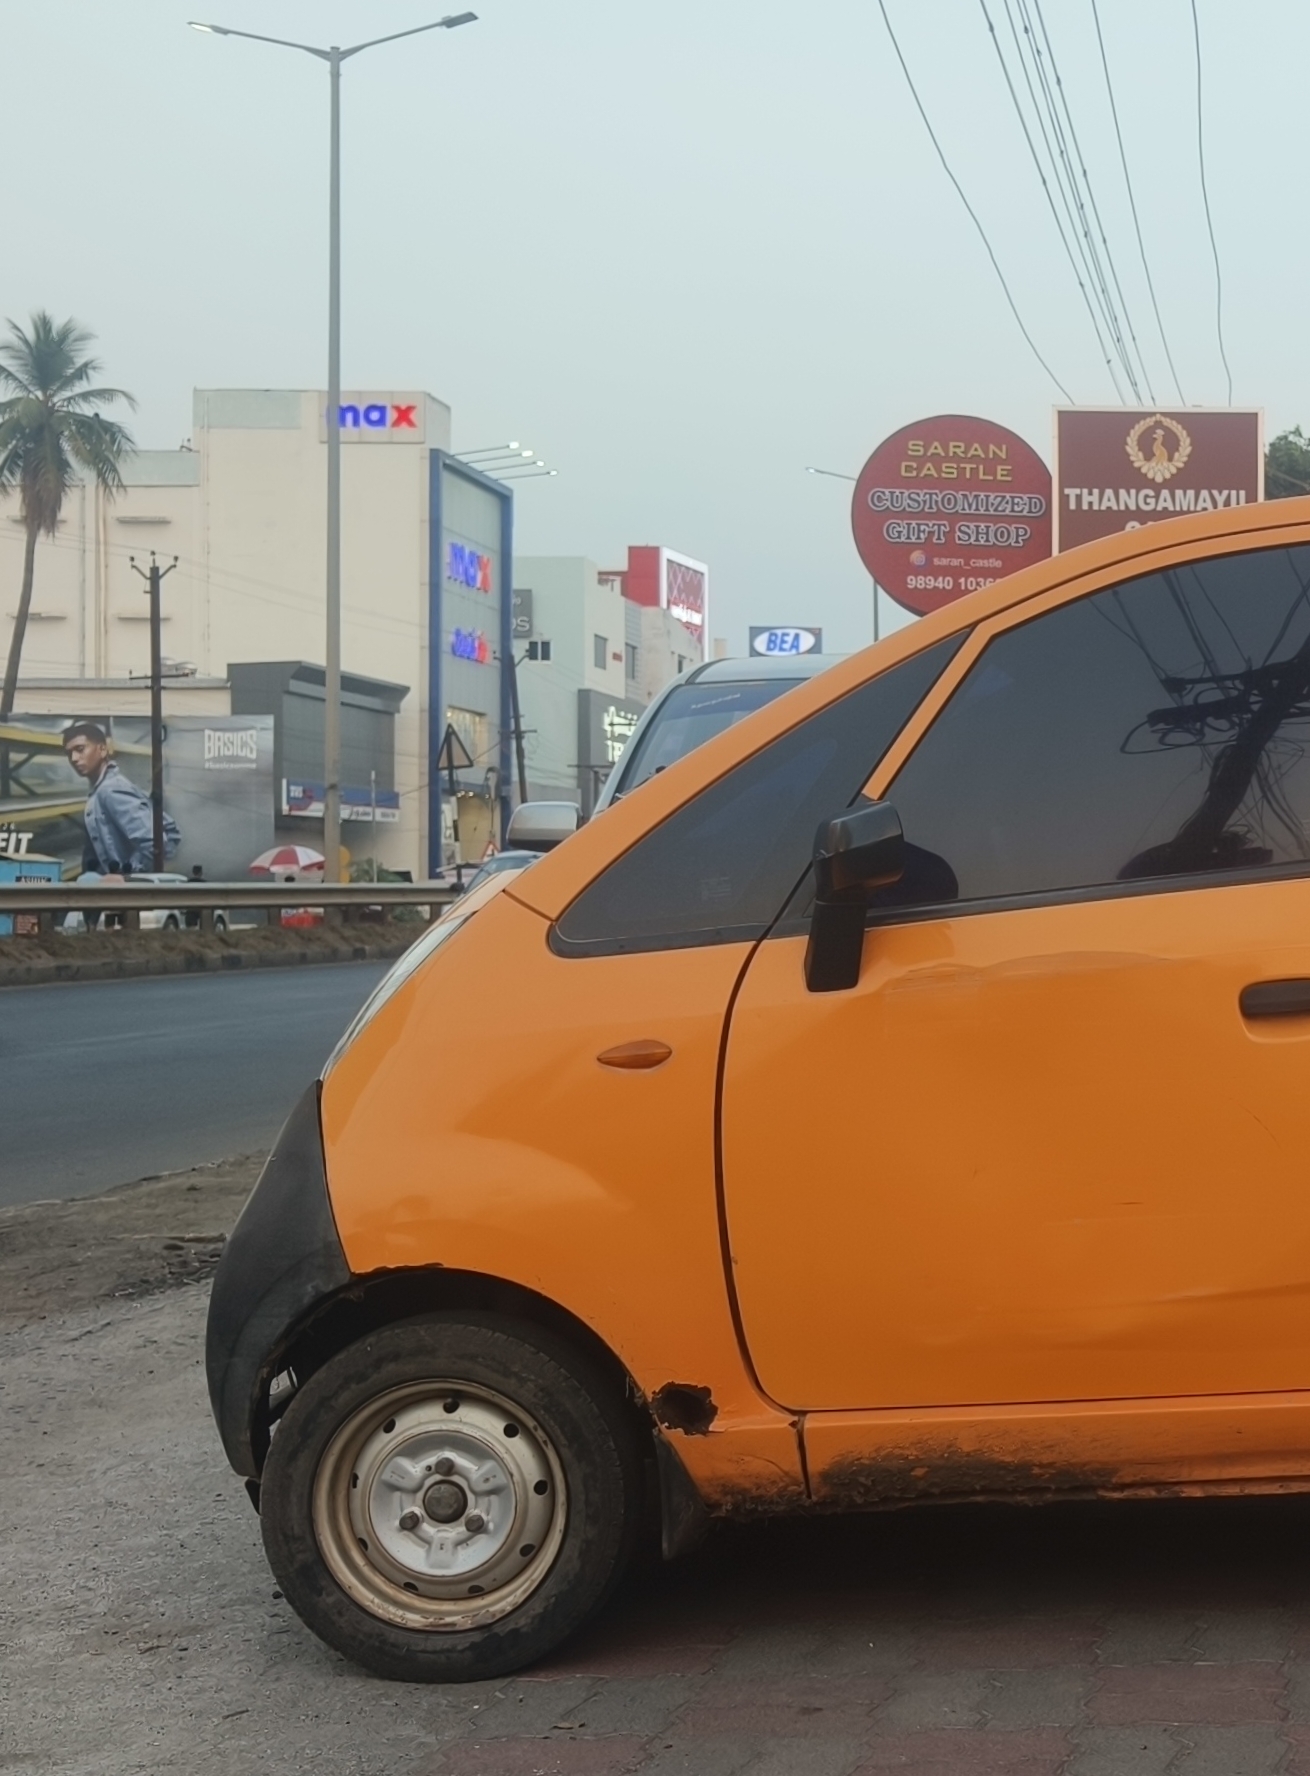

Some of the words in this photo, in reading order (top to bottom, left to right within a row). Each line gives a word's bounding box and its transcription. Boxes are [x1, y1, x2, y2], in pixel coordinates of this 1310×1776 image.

[907, 441, 1008, 460] SARAN
[900, 461, 1013, 482] CASTLE
[868, 488, 1046, 517] CUSTOMIZED
[884, 520, 949, 545] GIFT
[954, 522, 1031, 547] SHOP
[932, 555, 1003, 569] saran_castle
[906, 575, 953, 590] 98940
[958, 577, 1002, 591] 1036
[765, 631, 800, 653] BEA
[204, 728, 257, 760] BASICS
